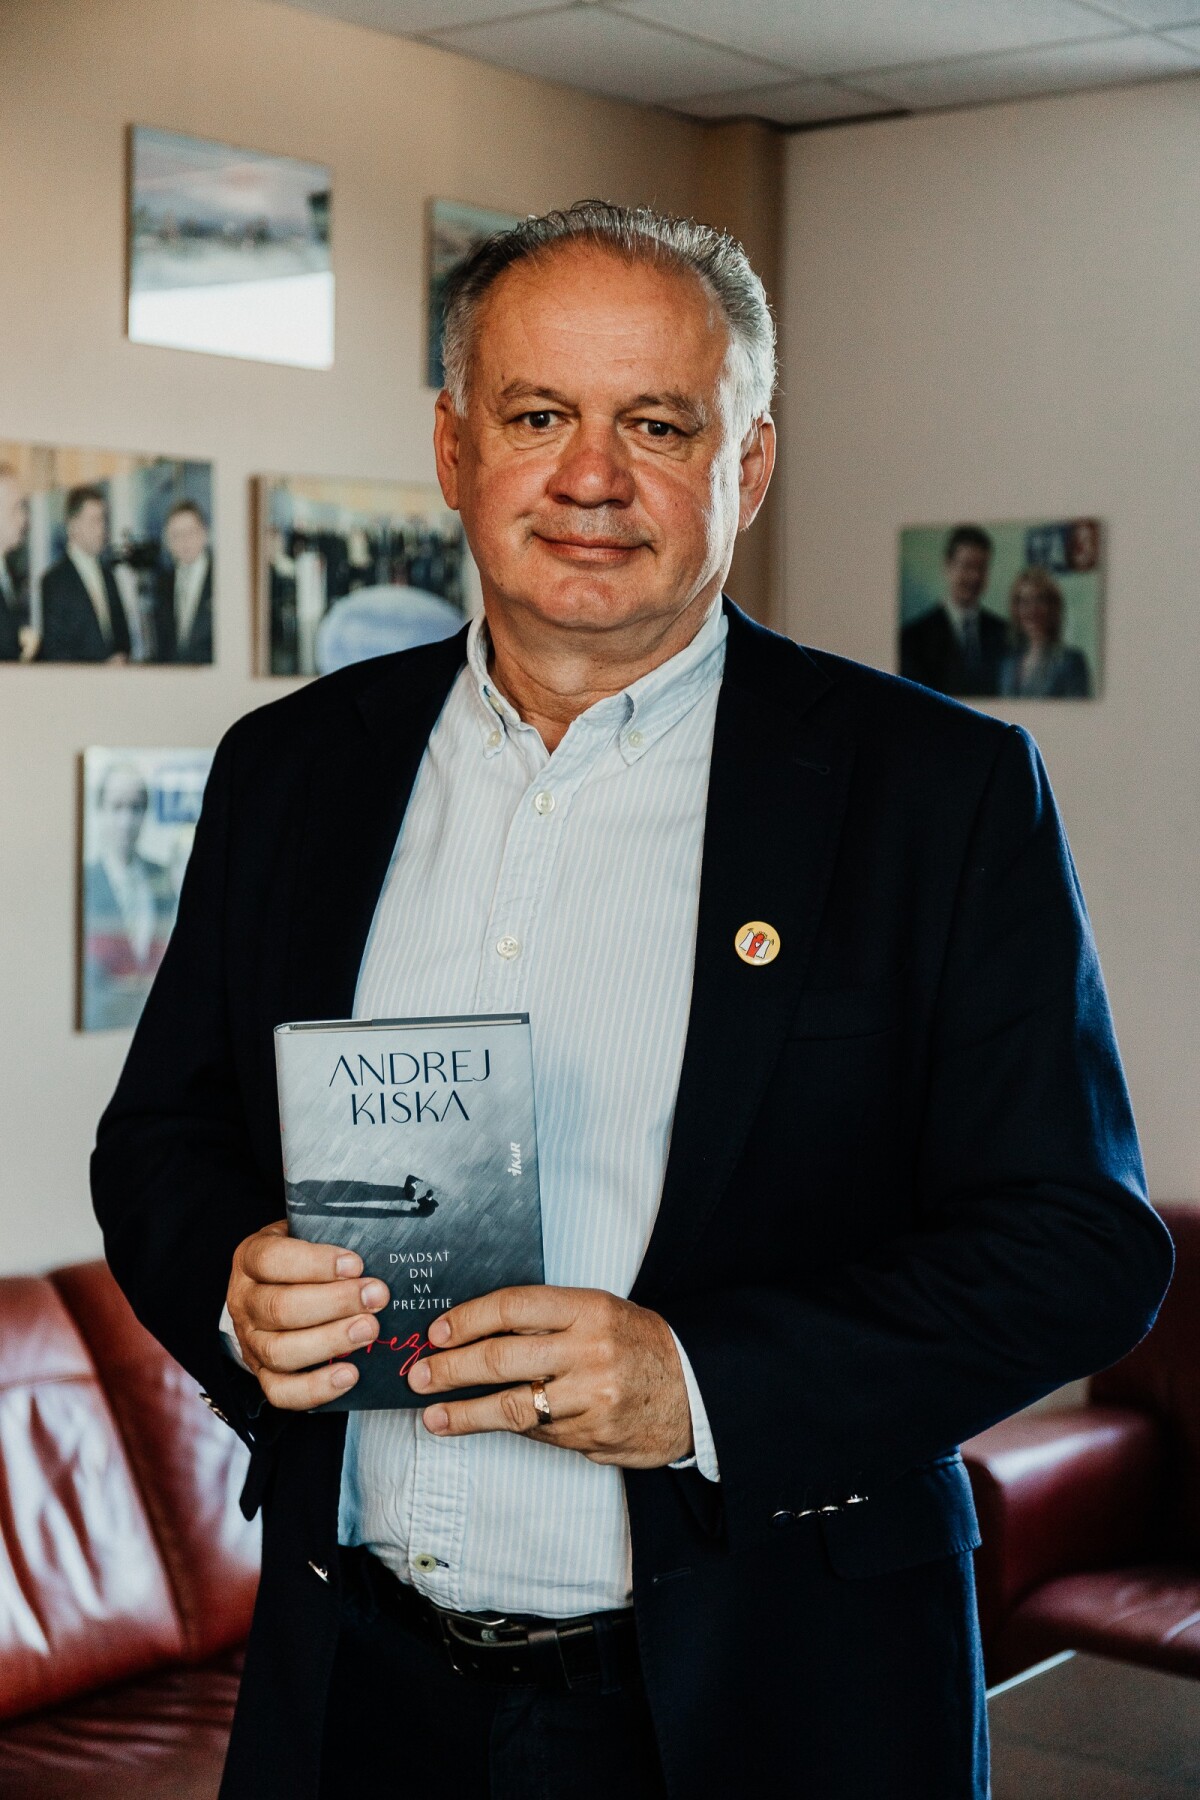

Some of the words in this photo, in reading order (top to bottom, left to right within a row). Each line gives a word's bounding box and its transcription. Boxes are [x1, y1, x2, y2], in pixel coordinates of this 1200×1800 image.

[329, 1049, 490, 1087] ANDREJ
[352, 1090, 470, 1125] KISKA
[413, 1284, 431, 1293] NA
[393, 1297, 452, 1310] PREŽITIE
